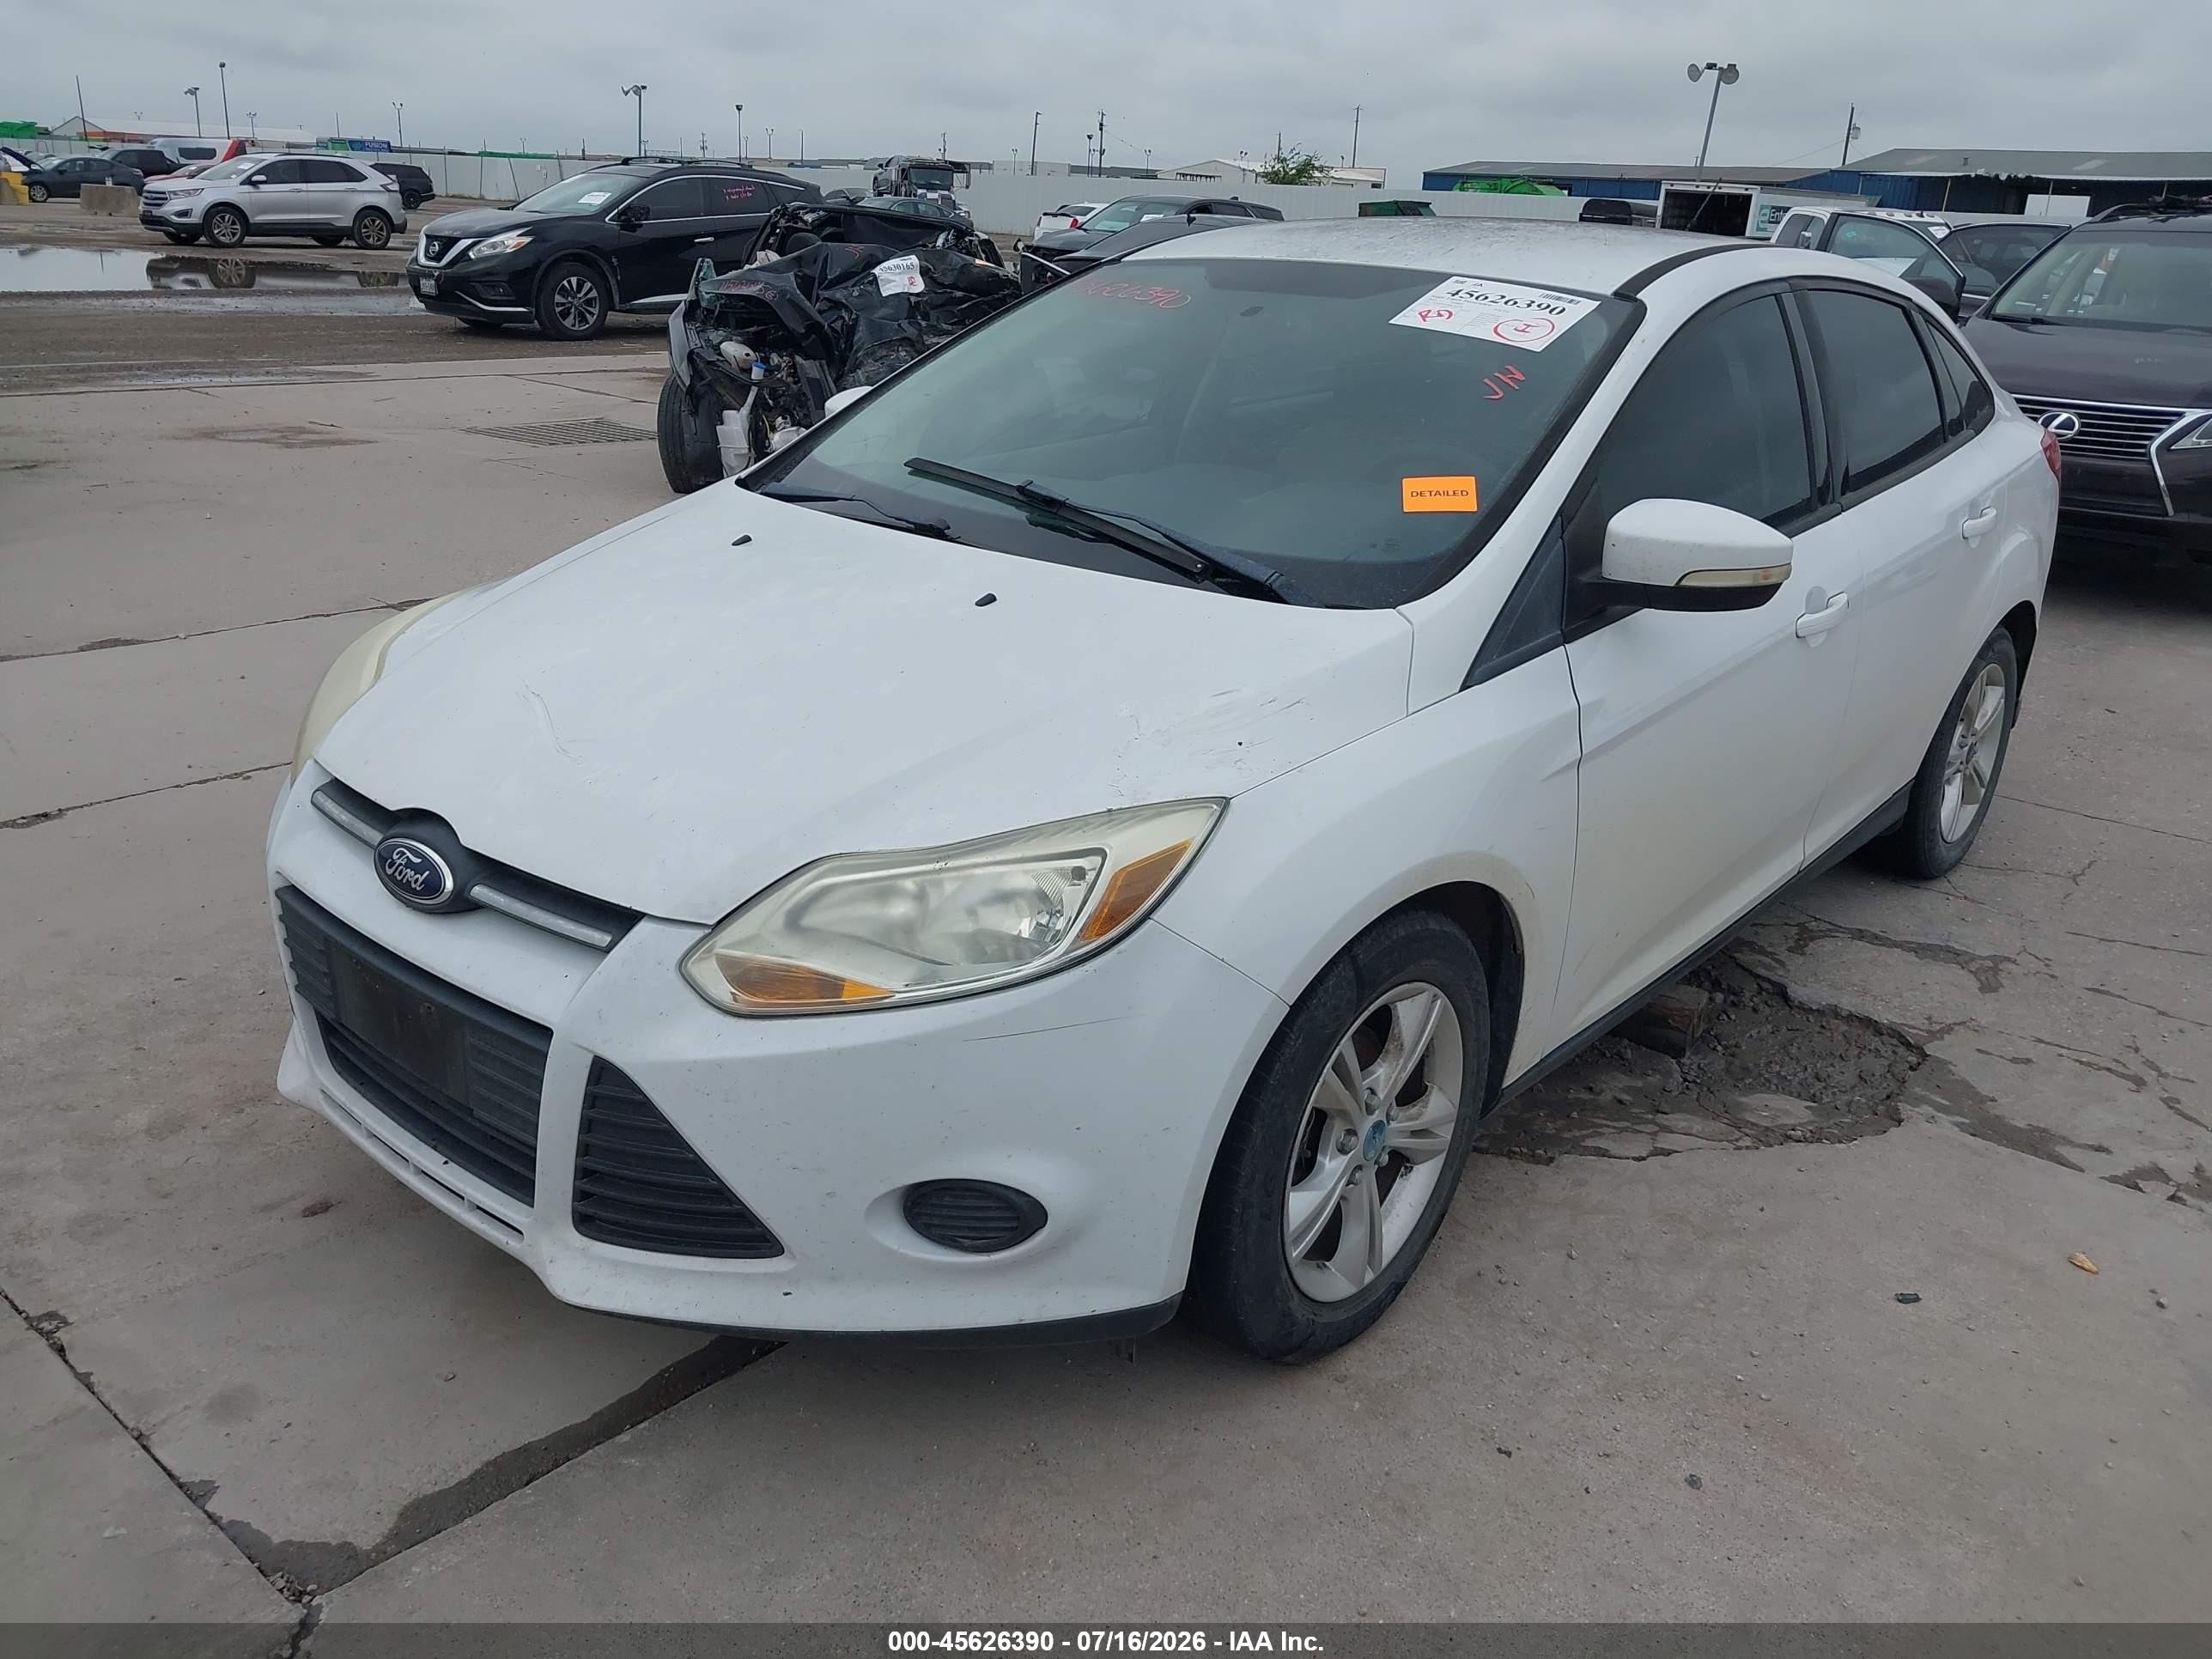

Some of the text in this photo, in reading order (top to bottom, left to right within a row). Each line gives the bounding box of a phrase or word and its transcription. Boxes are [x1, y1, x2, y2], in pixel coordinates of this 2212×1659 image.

[364, 141, 387, 149] FUSION
[1444, 289, 1566, 316] 45626390
[1411, 489, 1469, 498] DETAILED
[385, 847, 430, 890] Ford
